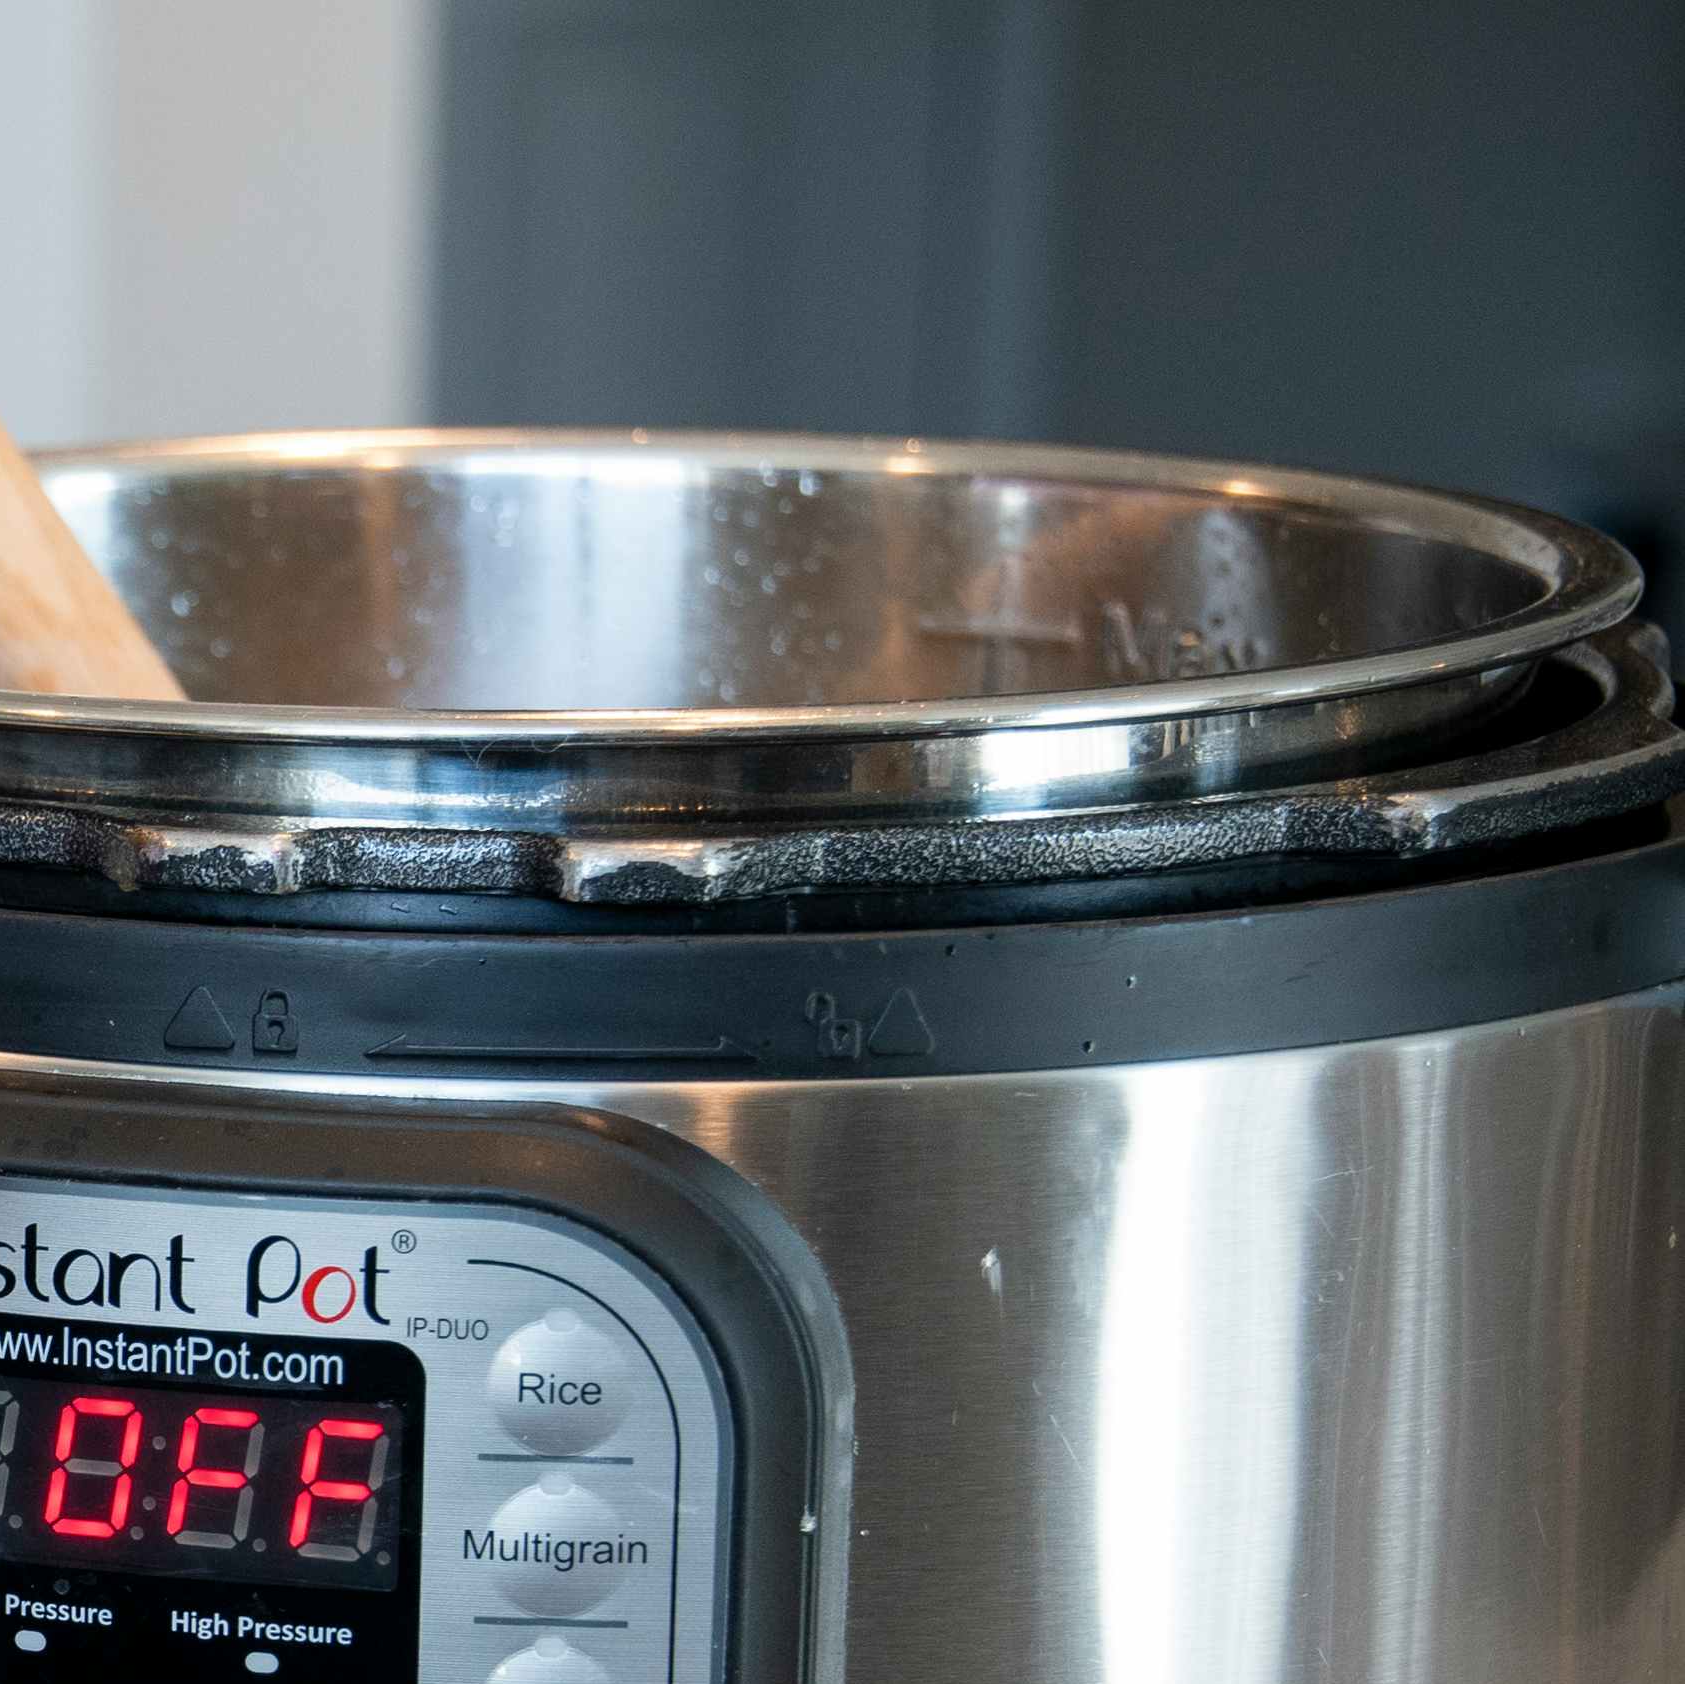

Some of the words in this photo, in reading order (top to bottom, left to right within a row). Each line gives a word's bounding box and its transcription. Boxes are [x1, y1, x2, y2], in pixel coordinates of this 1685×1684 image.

[407, 1317, 489, 1340] IP-DUO
[519, 1373, 601, 1405] Rice
[464, 1530, 647, 1572] Multigrain
[5, 1595, 113, 1626] Pressure
[172, 1611, 228, 1639] High
[239, 1617, 352, 1644] Pressure
